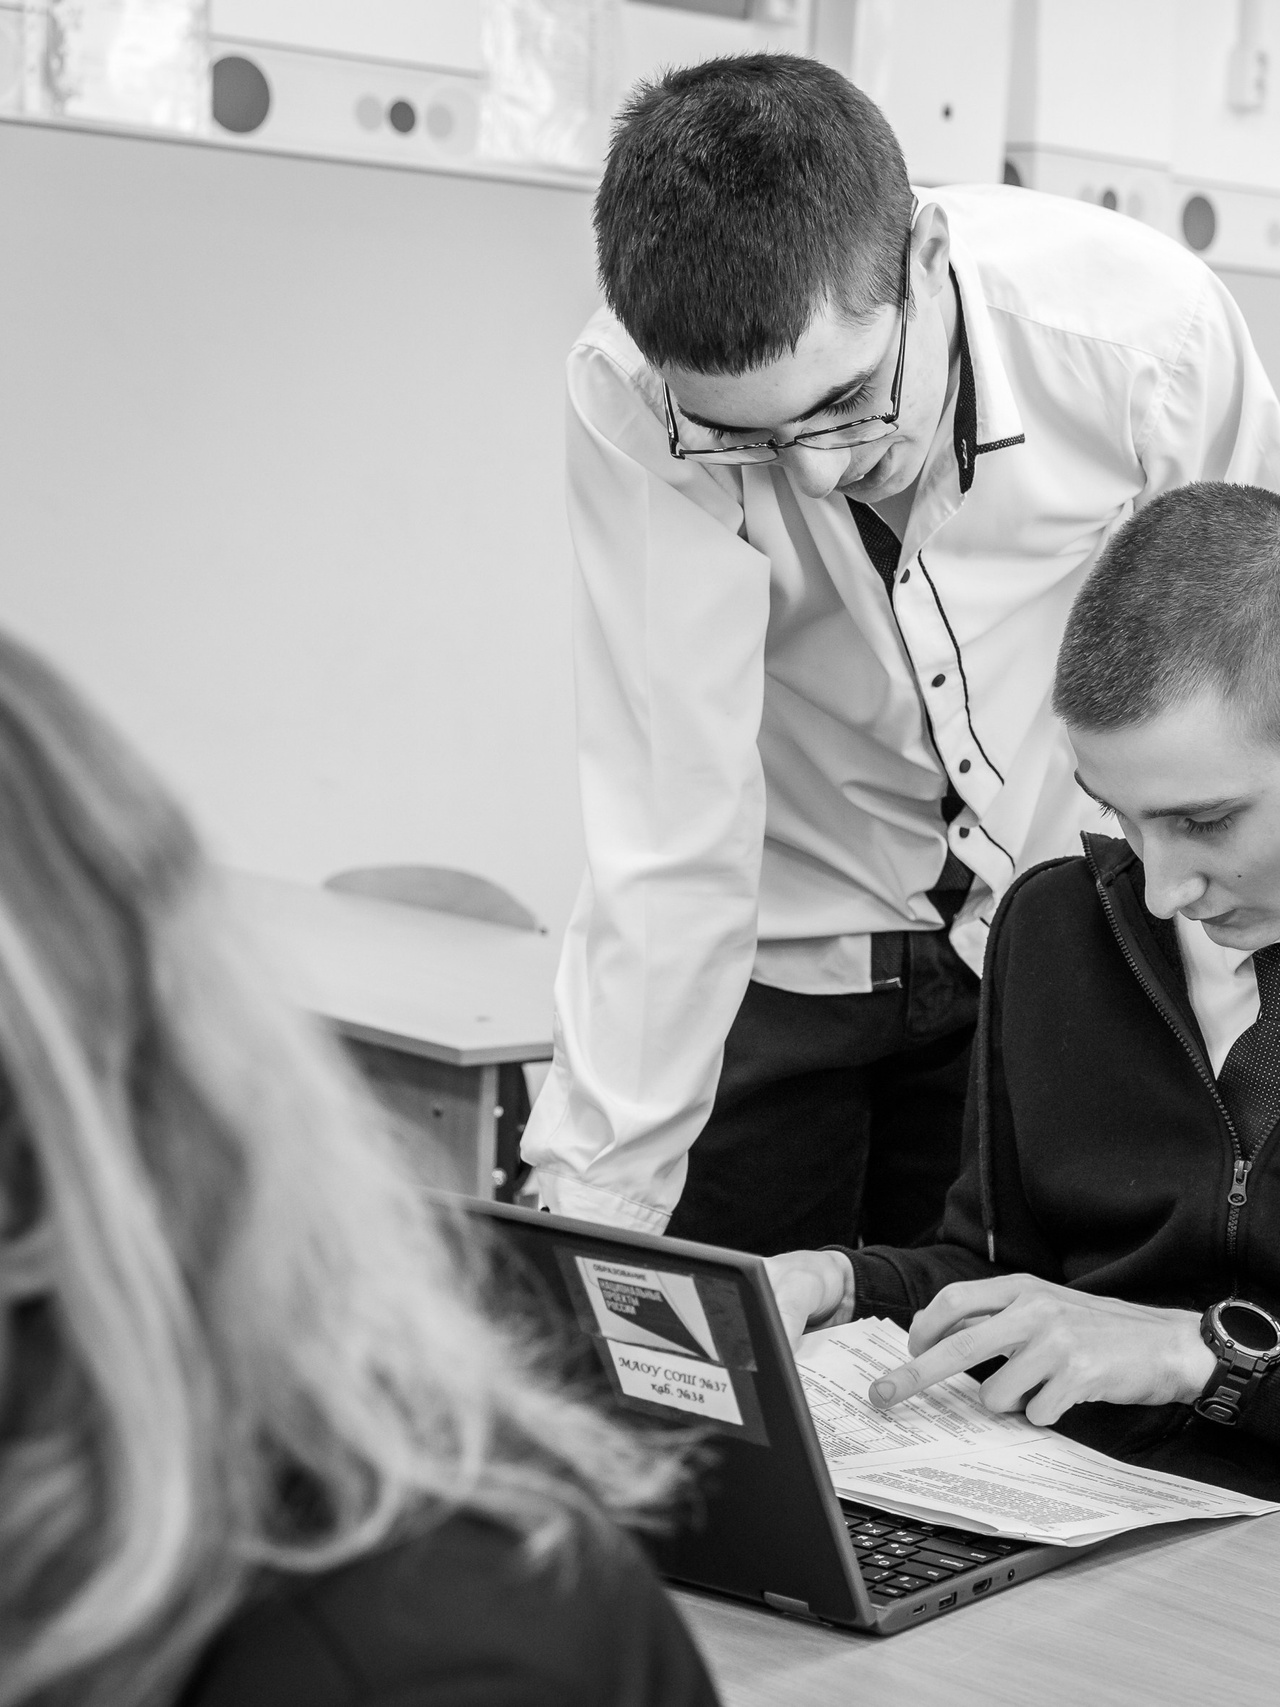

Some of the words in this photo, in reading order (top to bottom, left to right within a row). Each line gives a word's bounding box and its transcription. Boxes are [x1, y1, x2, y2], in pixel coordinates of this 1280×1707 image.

[618, 1357, 662, 1377] МАОУ
[664, 1369, 697, 1386] СОШ
[699, 1377, 728, 1393] №37
[676, 1388, 705, 1404] №38
